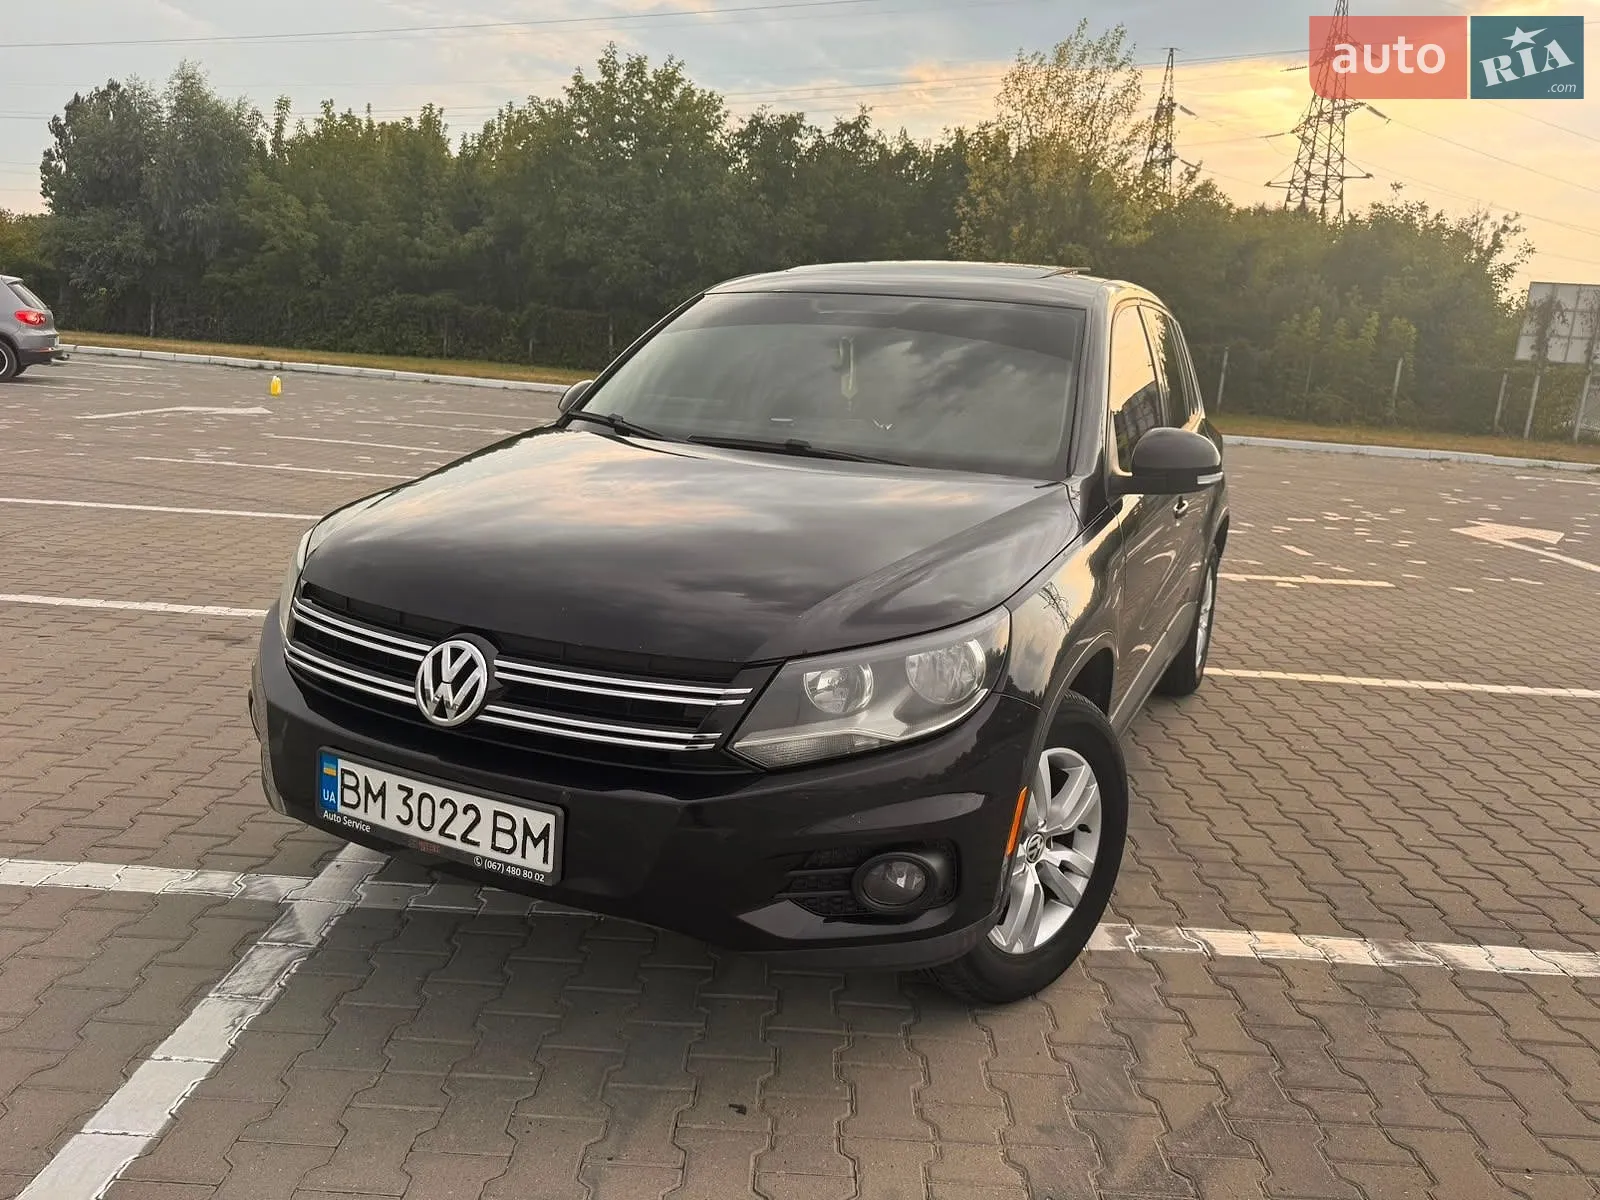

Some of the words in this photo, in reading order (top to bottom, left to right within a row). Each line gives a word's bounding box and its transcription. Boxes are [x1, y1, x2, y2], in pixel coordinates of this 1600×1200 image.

[322, 788, 337, 804] UA
[323, 810, 341, 823] Auto
[342, 816, 371, 833] Service
[340, 767, 387, 820] BM
[396, 784, 482, 847] 3022
[491, 809, 551, 865] BM
[484, 858, 505, 874] (067)
[506, 866, 521, 877] 480
[522, 869, 533, 880] 80
[534, 873, 545, 883] 02
